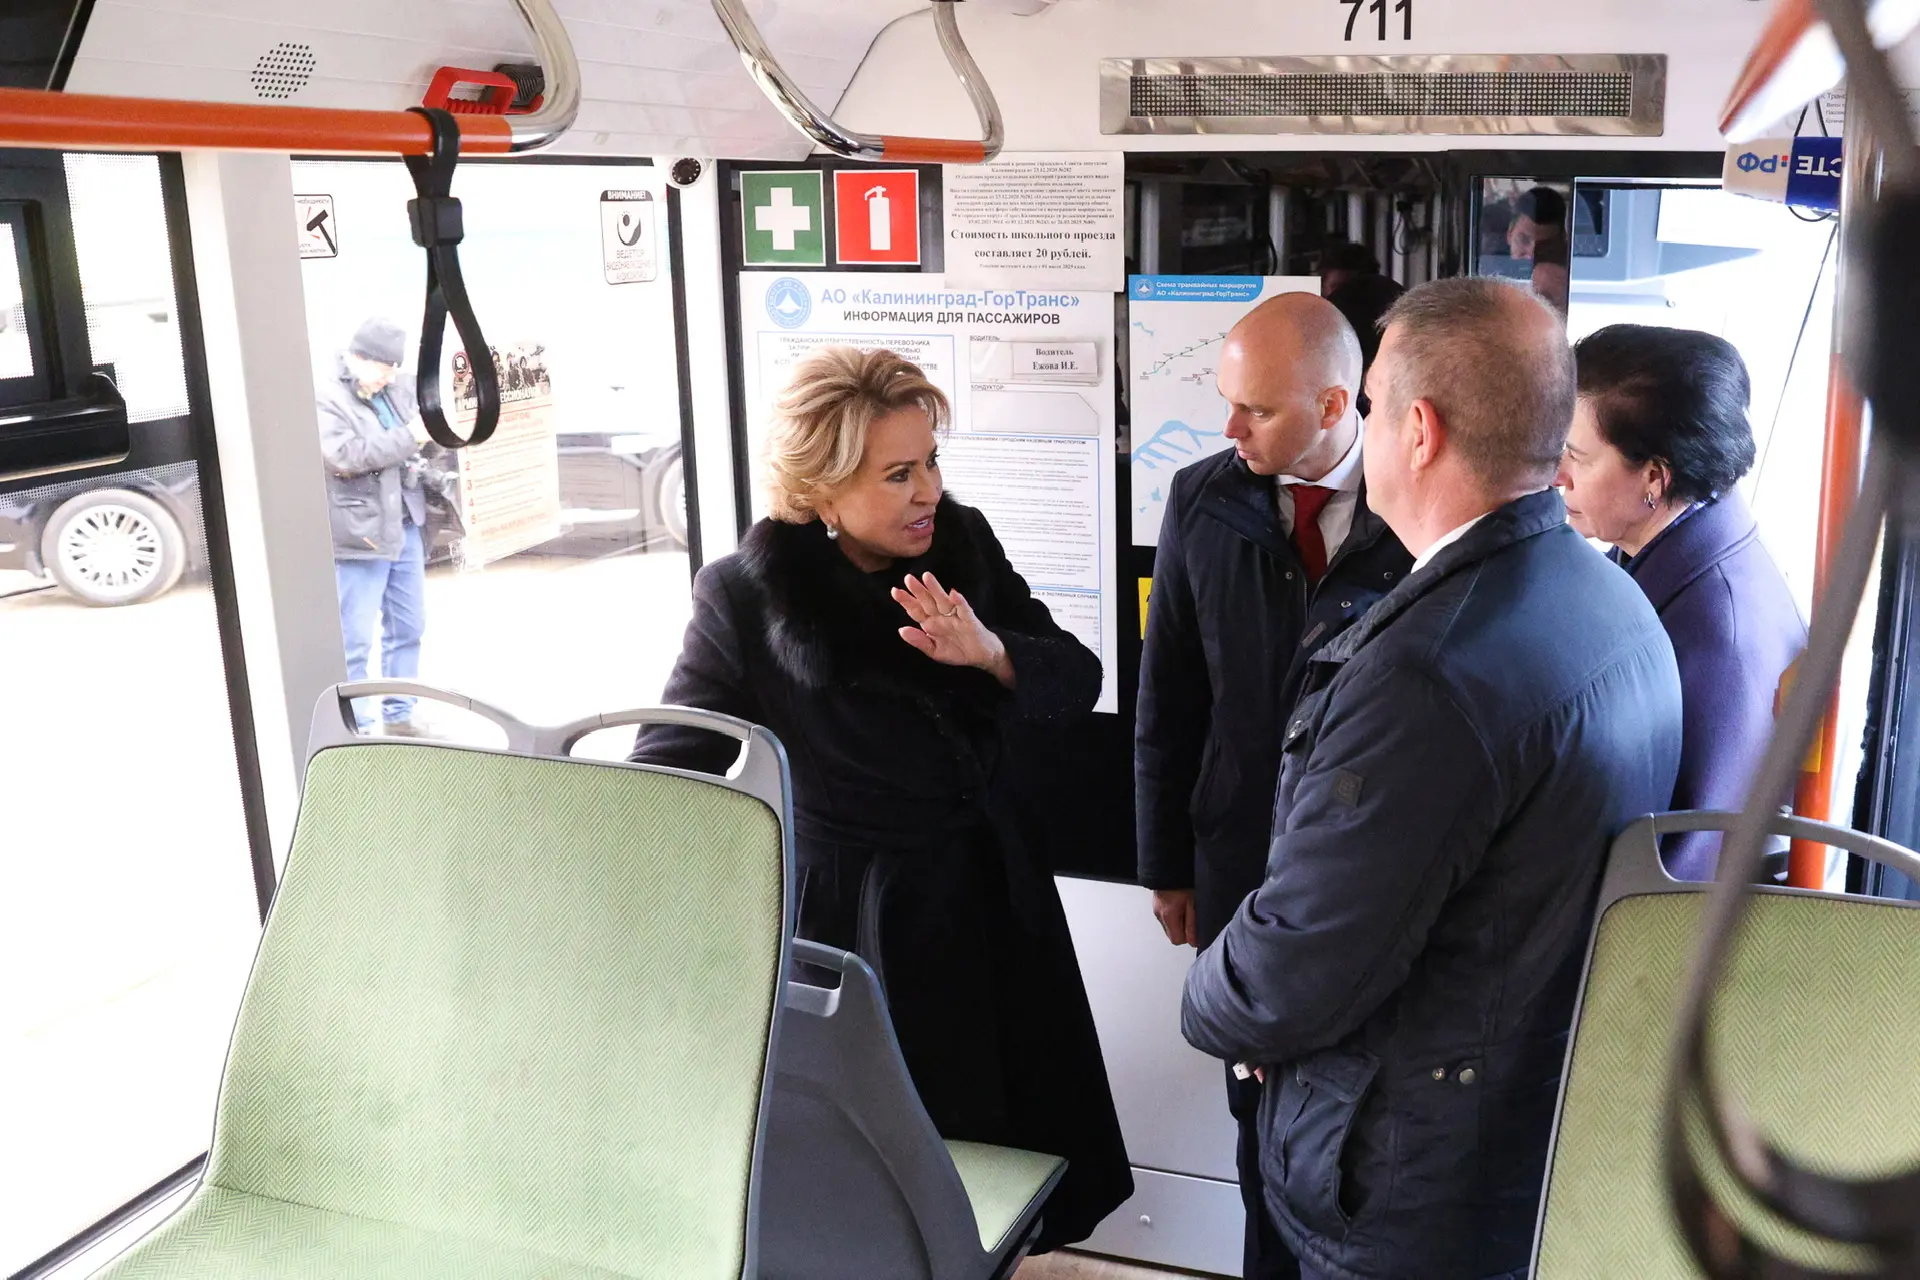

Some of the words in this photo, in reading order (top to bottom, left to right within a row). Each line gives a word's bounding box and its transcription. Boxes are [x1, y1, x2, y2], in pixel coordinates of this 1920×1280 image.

[1340, 0, 1412, 41] 711
[1796, 155, 1842, 178] СТЕ
[950, 229, 1009, 240] Стоимость
[1011, 230, 1071, 240] школьного
[1073, 231, 1116, 243] проезда
[974, 248, 1032, 258] составляет
[1036, 248, 1048, 258] 20
[1050, 248, 1091, 260] рублей.
[1219, 282, 1257, 290] маршрутов
[821, 288, 846, 304] АО
[852, 288, 1080, 310] «Калининград-ГорТранс»
[843, 310, 933, 324] ИНФОРМАЦИЯ
[937, 312, 963, 325] ДЛЯ
[967, 312, 1060, 325] ПАССАЖИРОВ
[885, 339, 931, 347] ПЕРЕВОЗЧИКА
[1035, 348, 1074, 356] Водитель
[1032, 361, 1059, 370] Ежова
